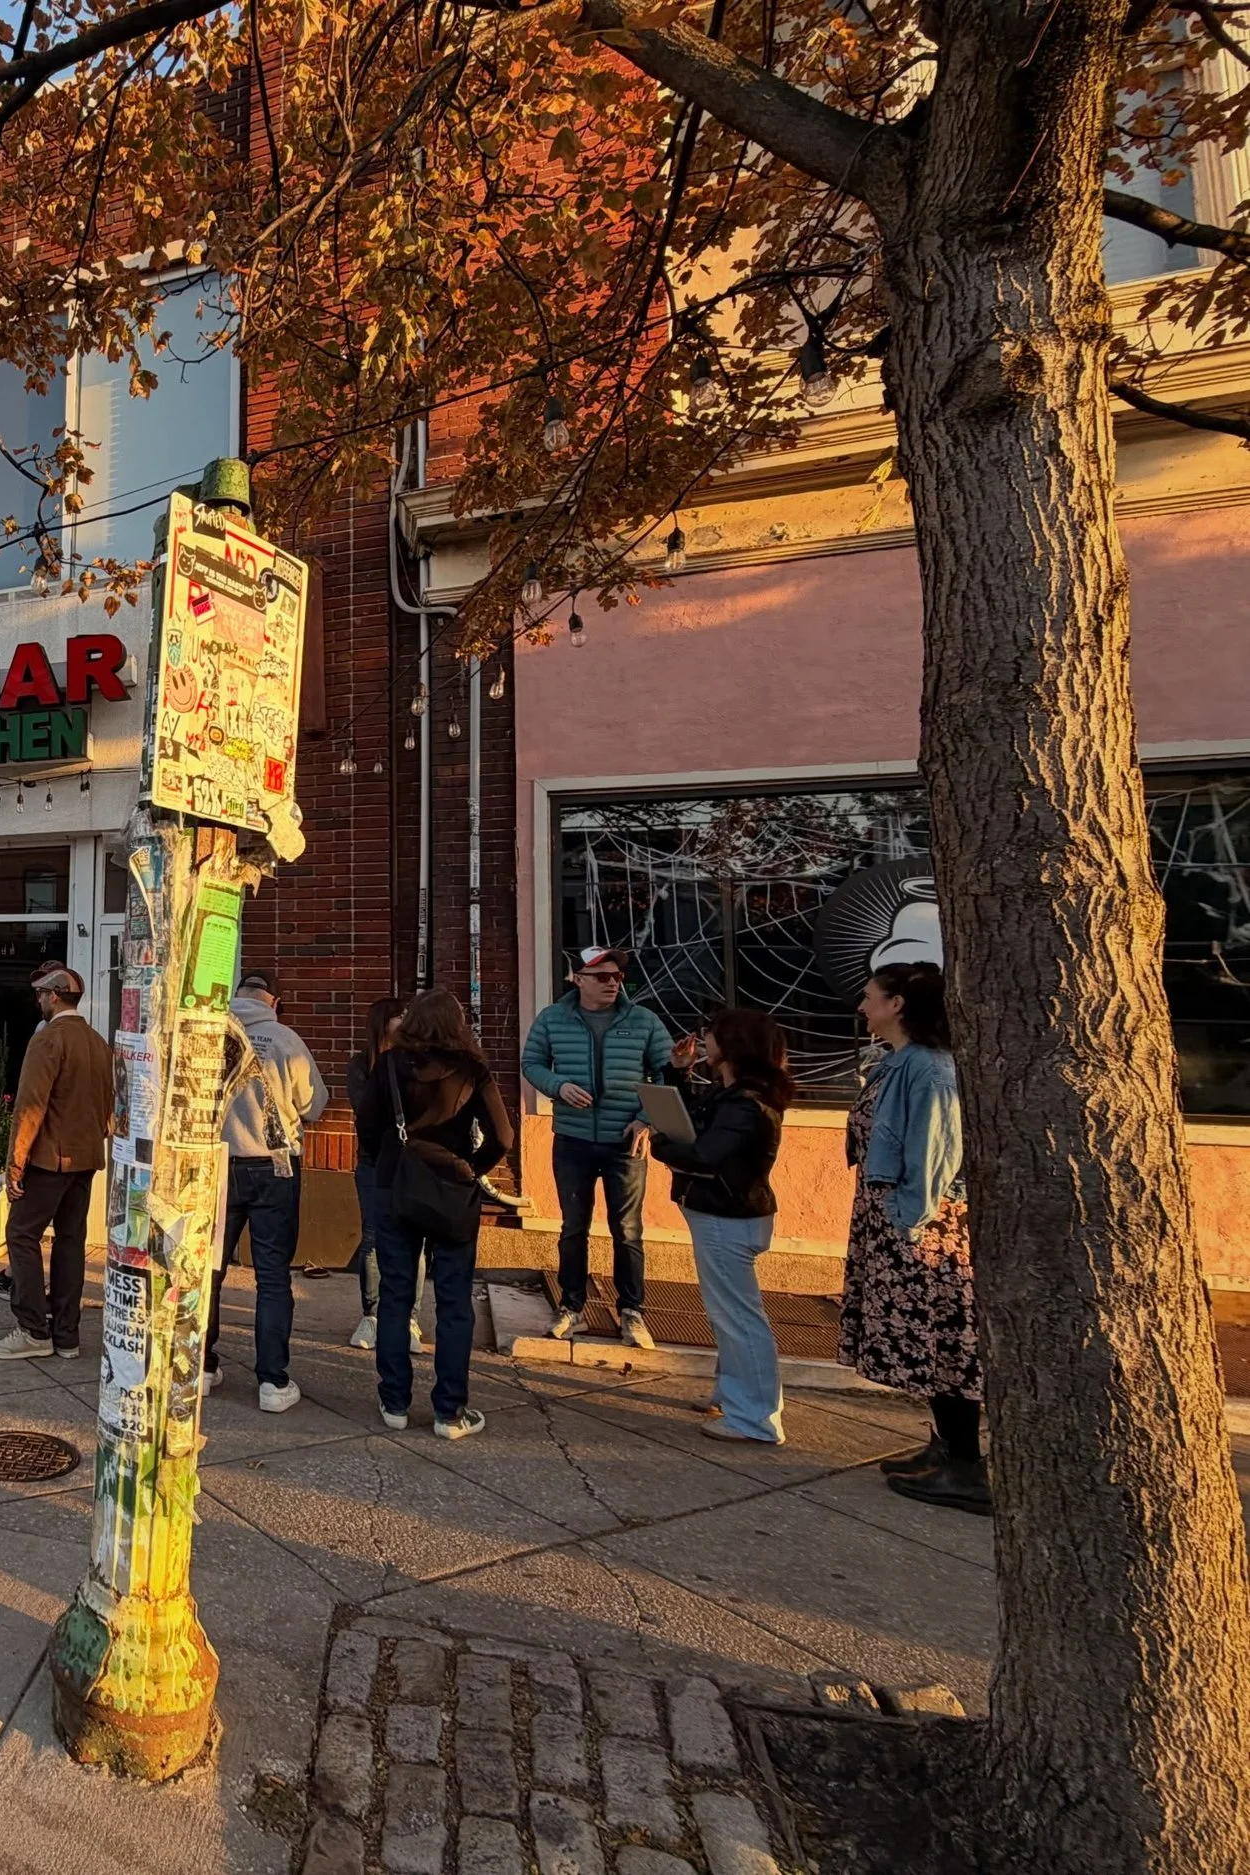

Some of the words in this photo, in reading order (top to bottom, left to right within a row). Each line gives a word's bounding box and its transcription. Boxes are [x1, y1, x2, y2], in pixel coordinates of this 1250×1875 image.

[113, 1289, 143, 1310] TIME
[120, 1386, 144, 1402] DC9
[121, 1418, 145, 1432] $20
